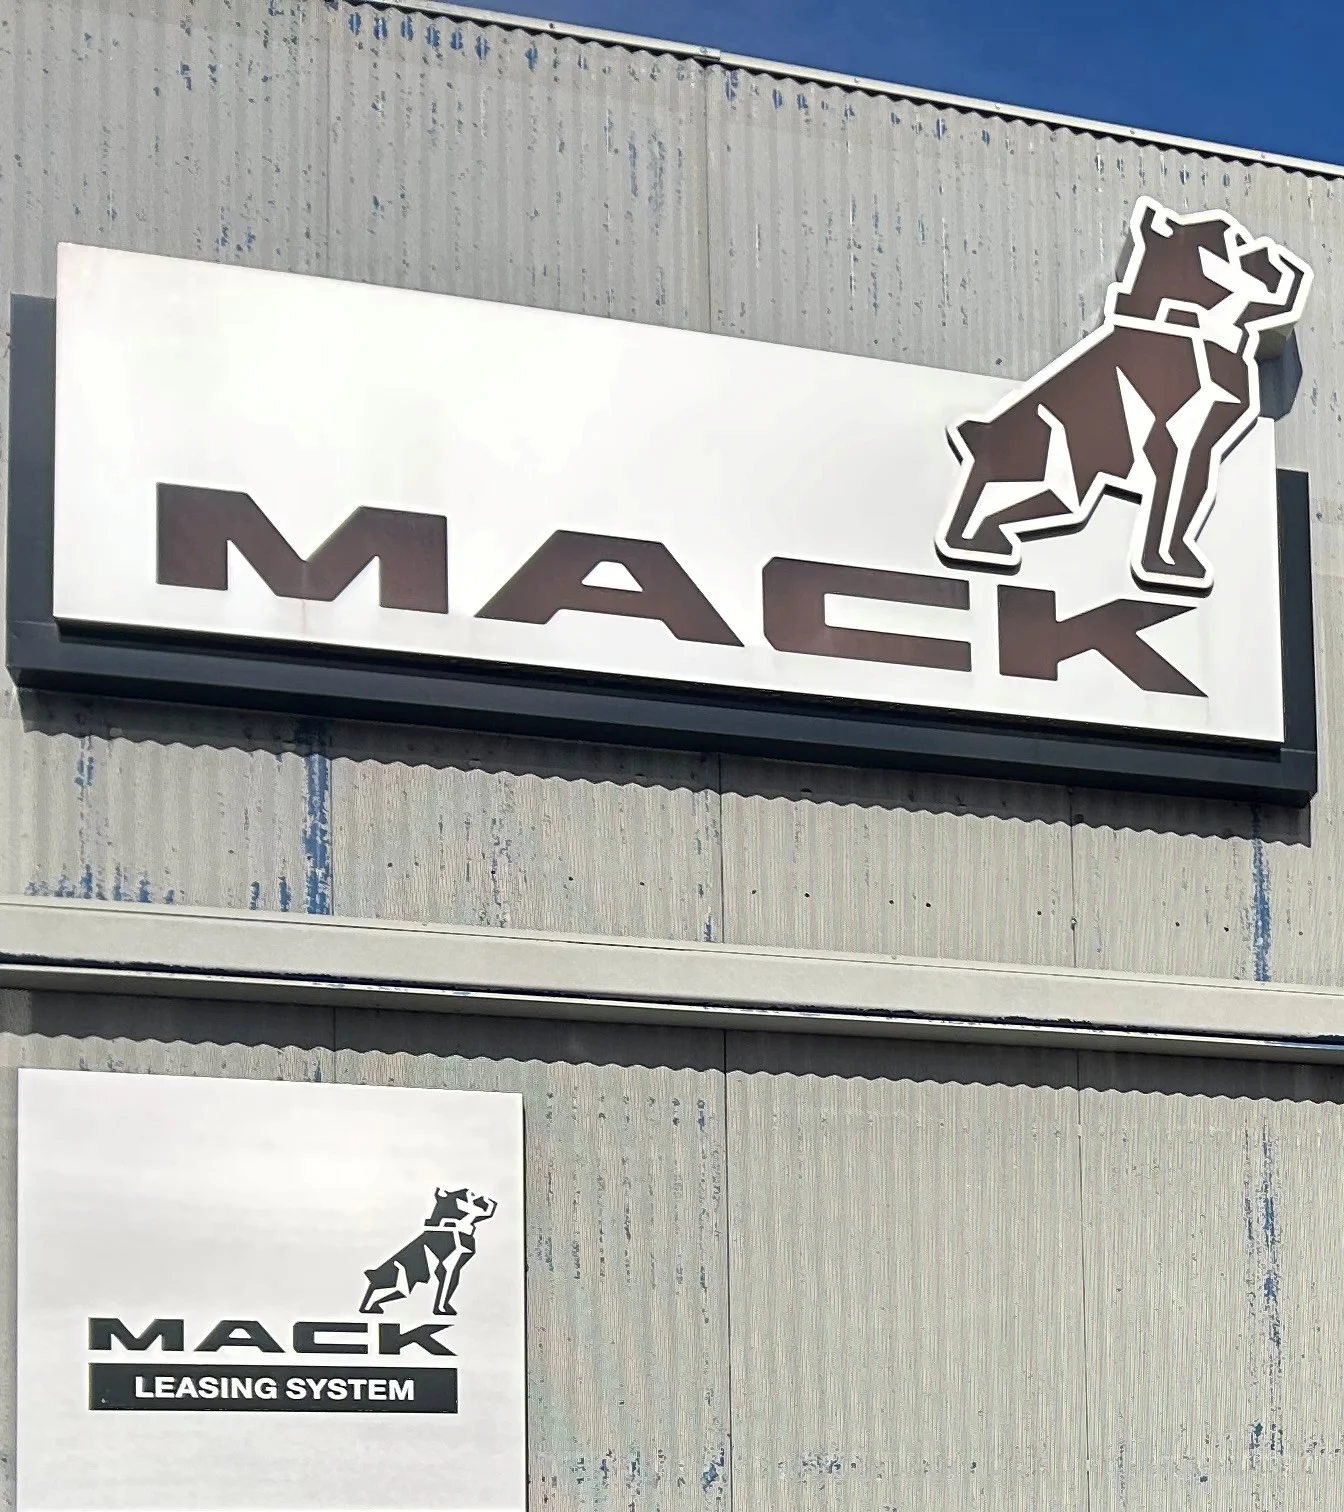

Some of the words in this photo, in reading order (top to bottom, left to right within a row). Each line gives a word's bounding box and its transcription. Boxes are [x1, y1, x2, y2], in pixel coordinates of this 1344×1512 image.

[156, 482, 1209, 698] MACK
[88, 1316, 459, 1357] MACK
[134, 1376, 278, 1400] LEASING
[286, 1377, 415, 1402] SYSTEM
